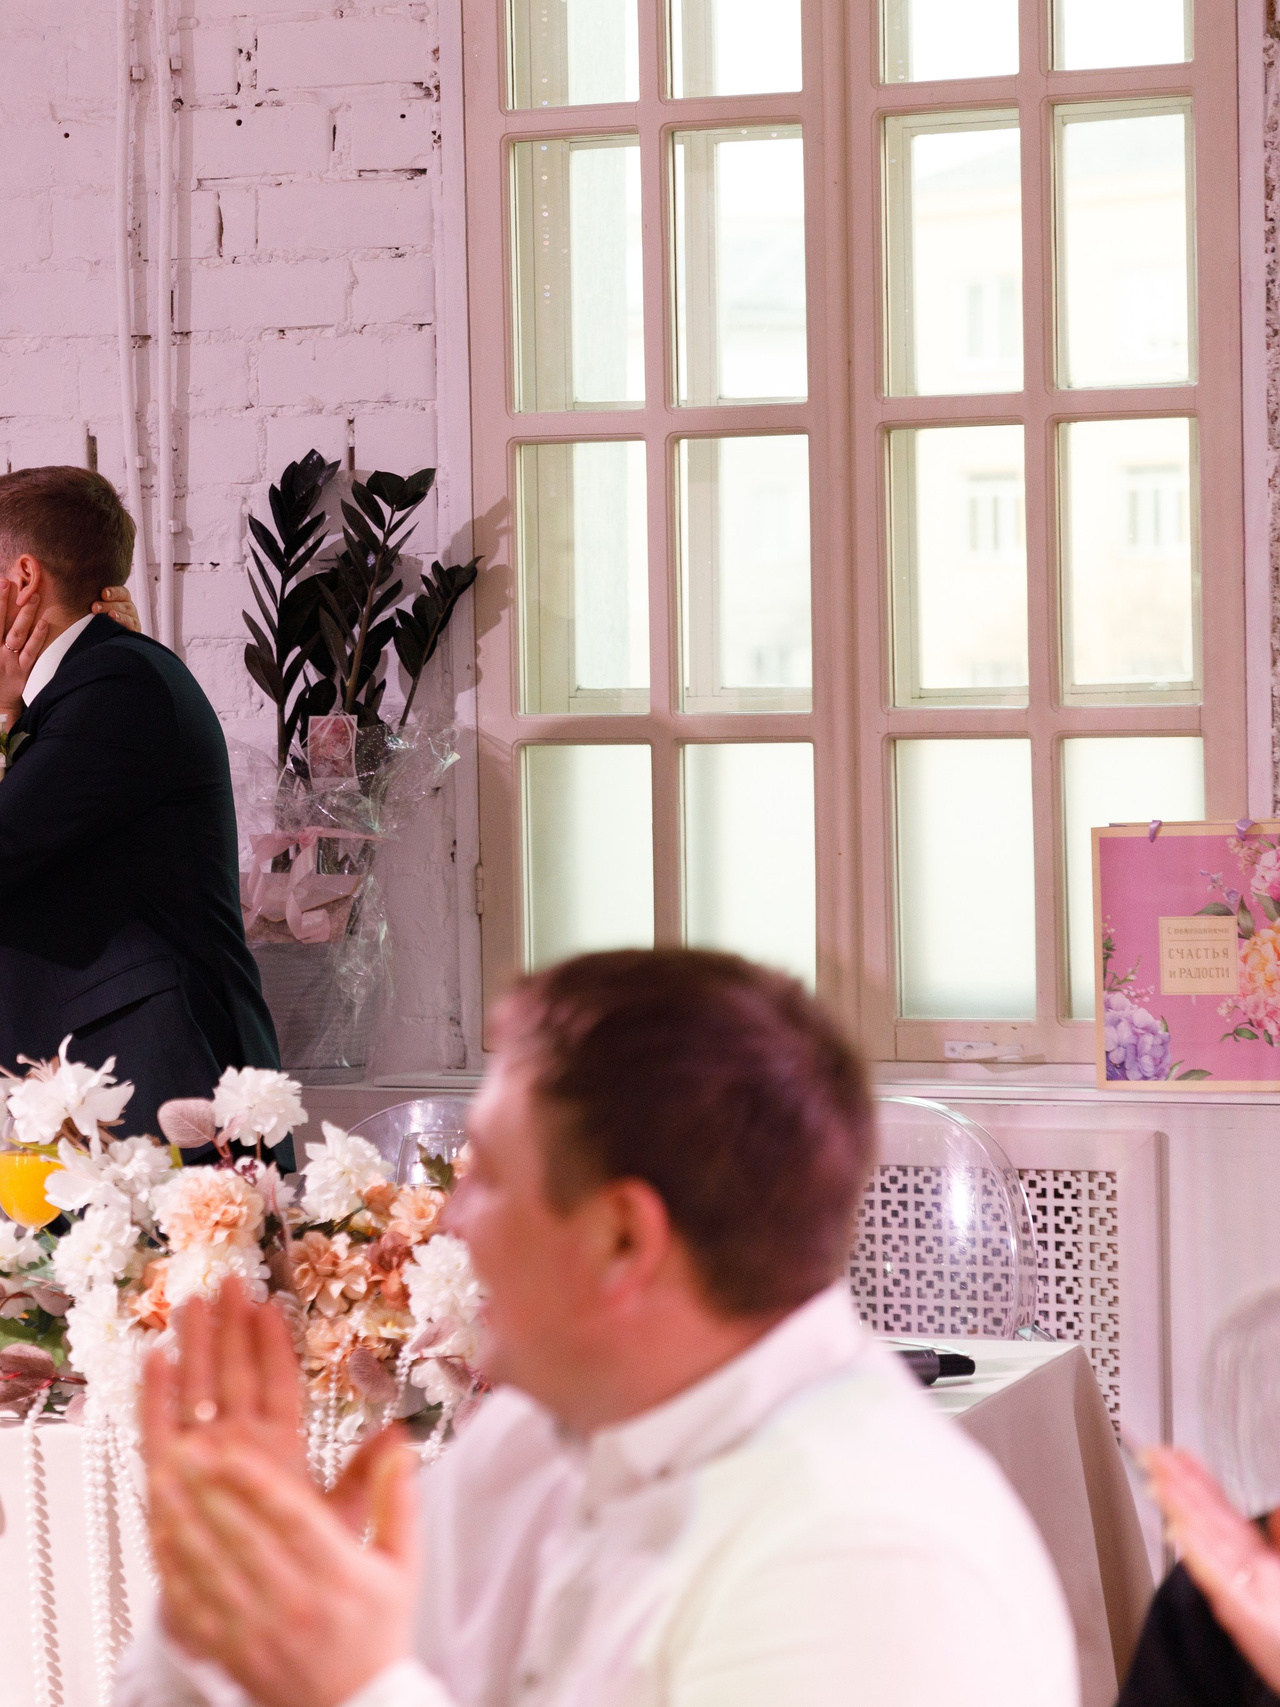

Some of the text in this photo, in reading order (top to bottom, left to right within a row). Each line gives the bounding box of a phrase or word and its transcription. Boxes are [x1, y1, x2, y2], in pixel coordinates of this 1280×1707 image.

[1168, 948, 1229, 959] СЧАСТЬЯ
[1169, 967, 1230, 979] и РАДОСТИ
